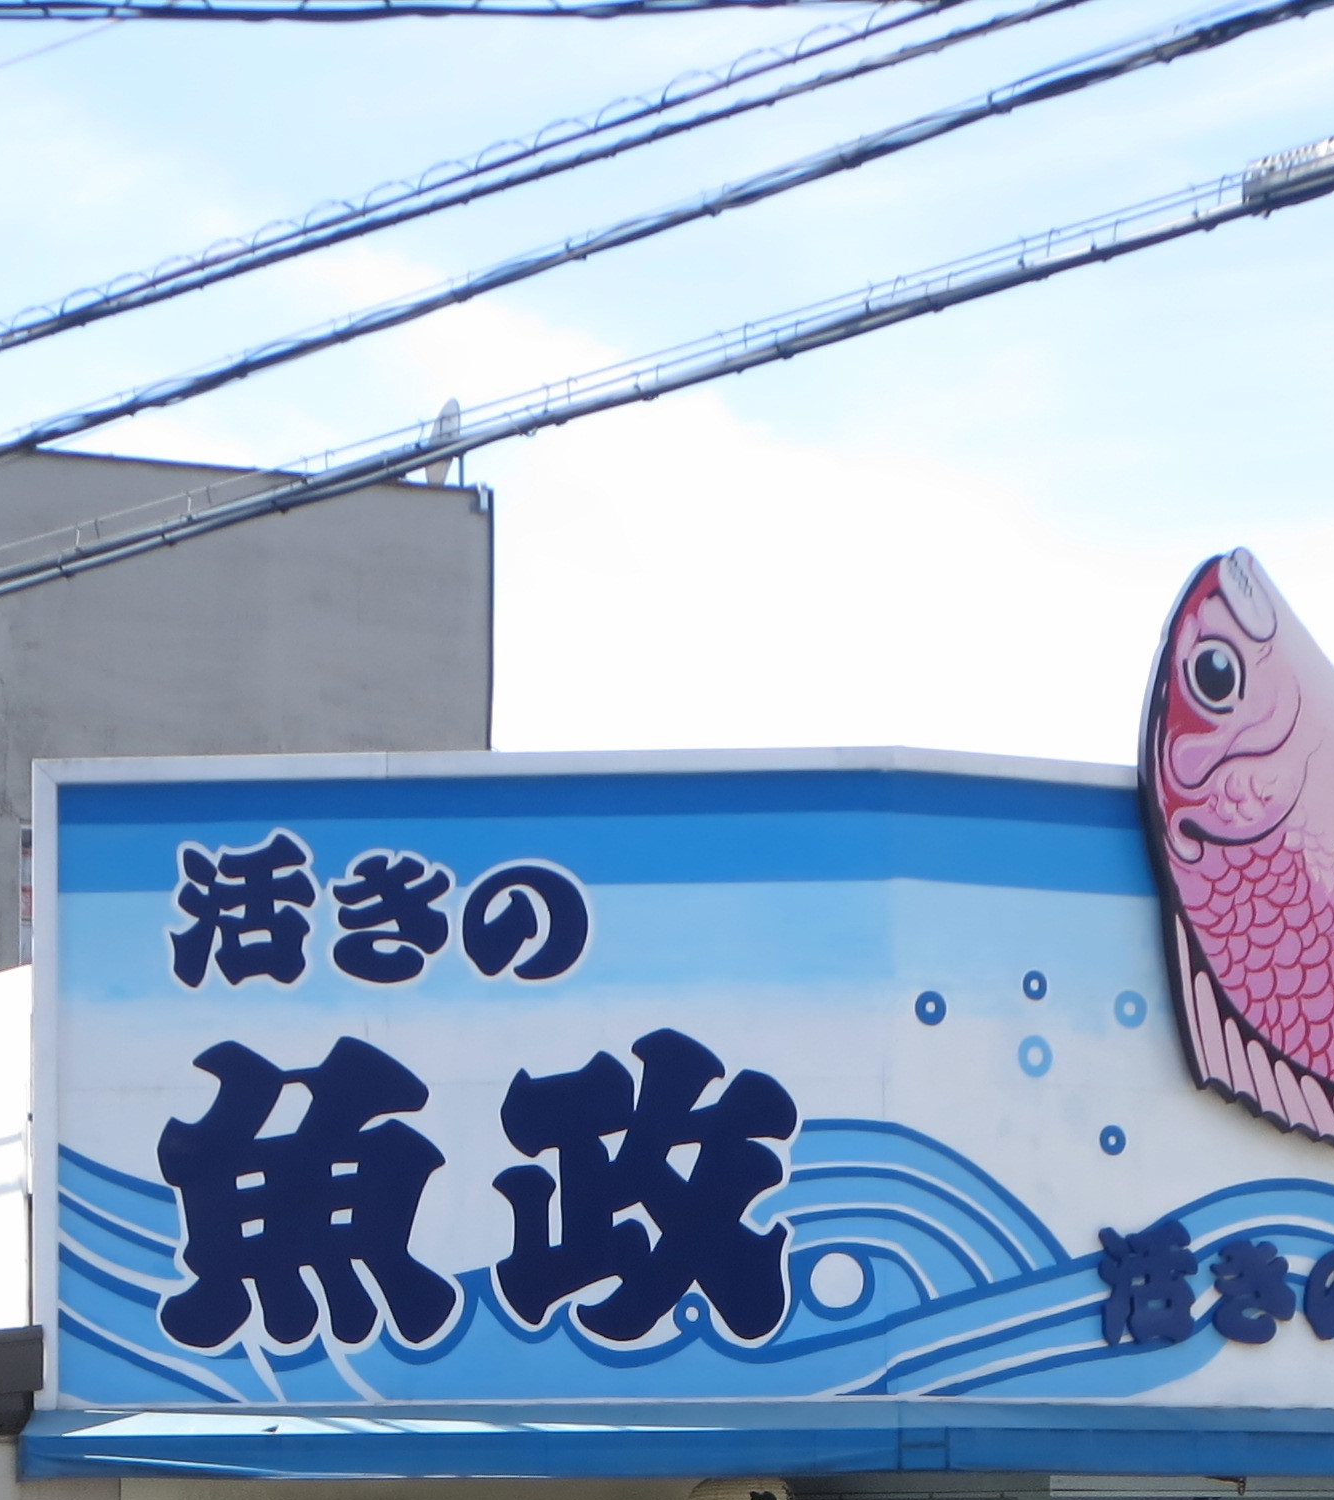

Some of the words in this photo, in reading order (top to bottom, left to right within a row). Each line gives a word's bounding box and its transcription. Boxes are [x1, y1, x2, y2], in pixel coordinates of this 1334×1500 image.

[167, 832, 591, 988] 活きの
[157, 1028, 799, 1346] 魚政
